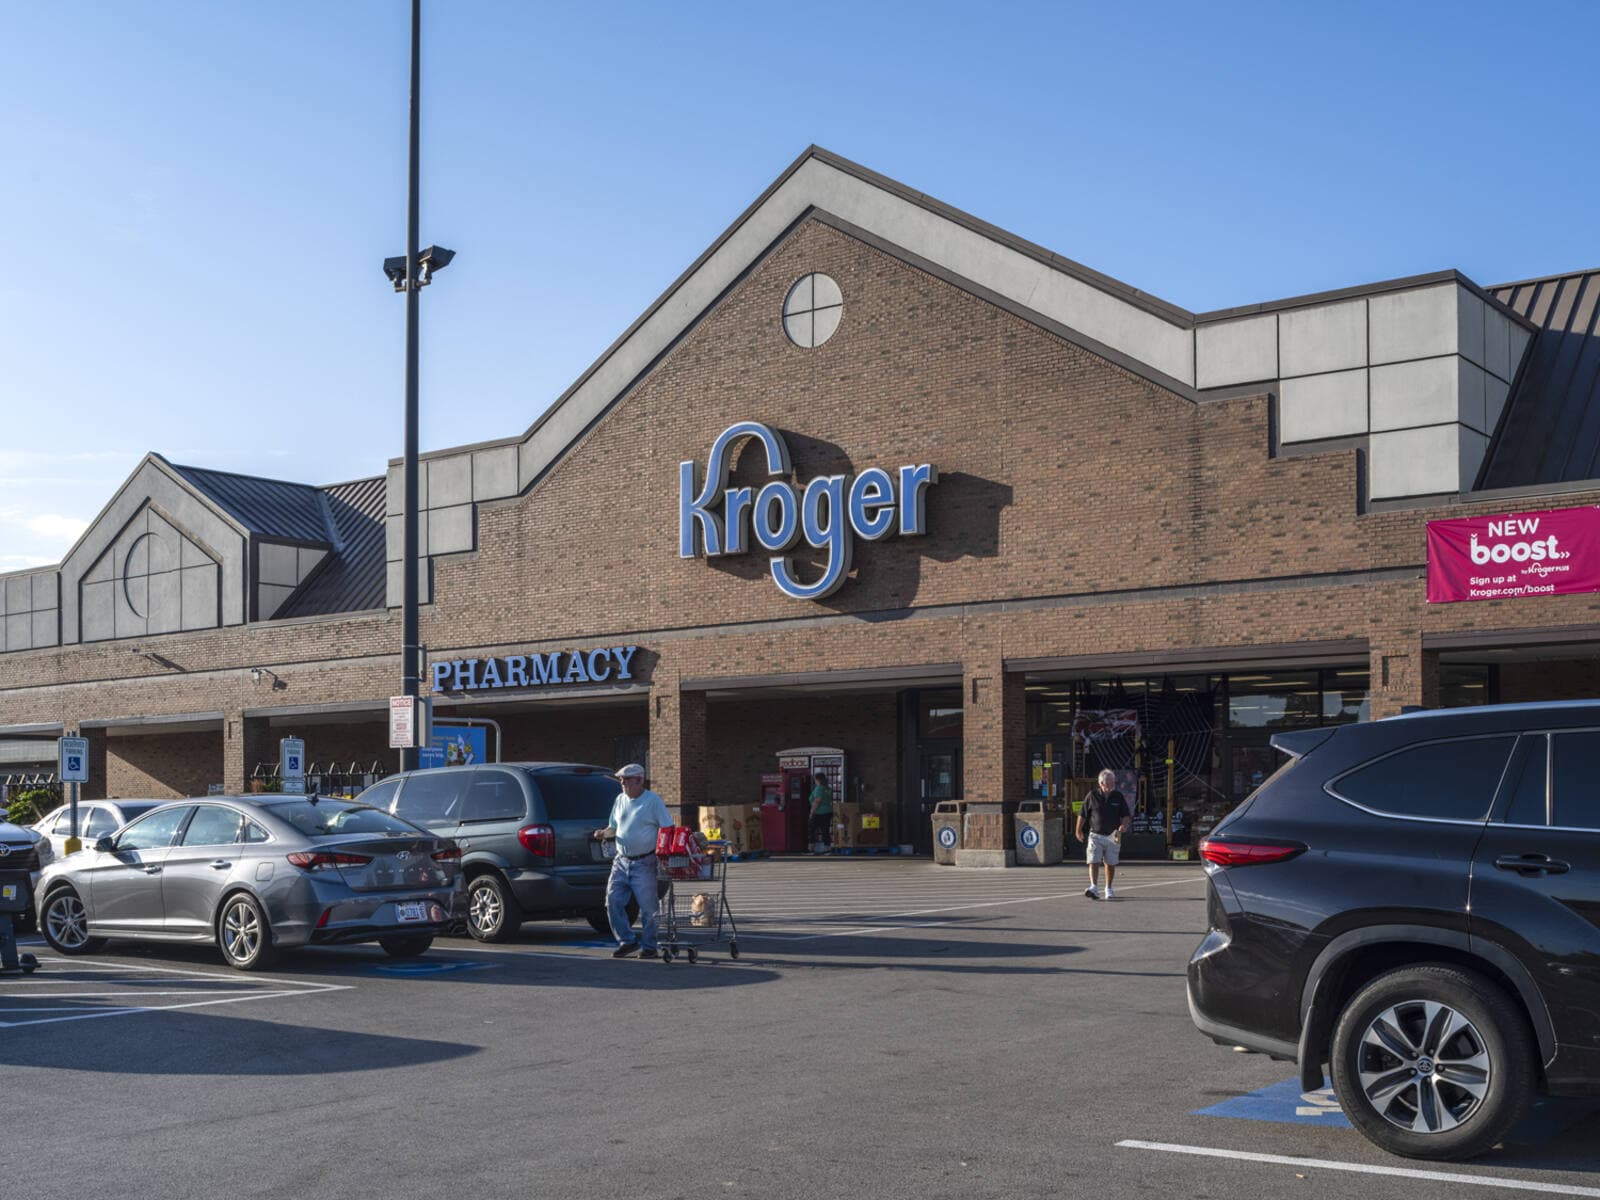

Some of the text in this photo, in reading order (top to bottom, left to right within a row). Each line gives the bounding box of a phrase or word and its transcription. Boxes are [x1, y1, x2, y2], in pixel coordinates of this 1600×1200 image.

[680, 421, 933, 599] Kroger
[1488, 518, 1540, 538] NEW
[1470, 534, 1560, 565] boost
[1470, 577, 1490, 586] Sign
[1493, 576, 1505, 584] up
[1470, 584, 1555, 597] Kroger.com/boost
[431, 646, 637, 692] PHARMACY
